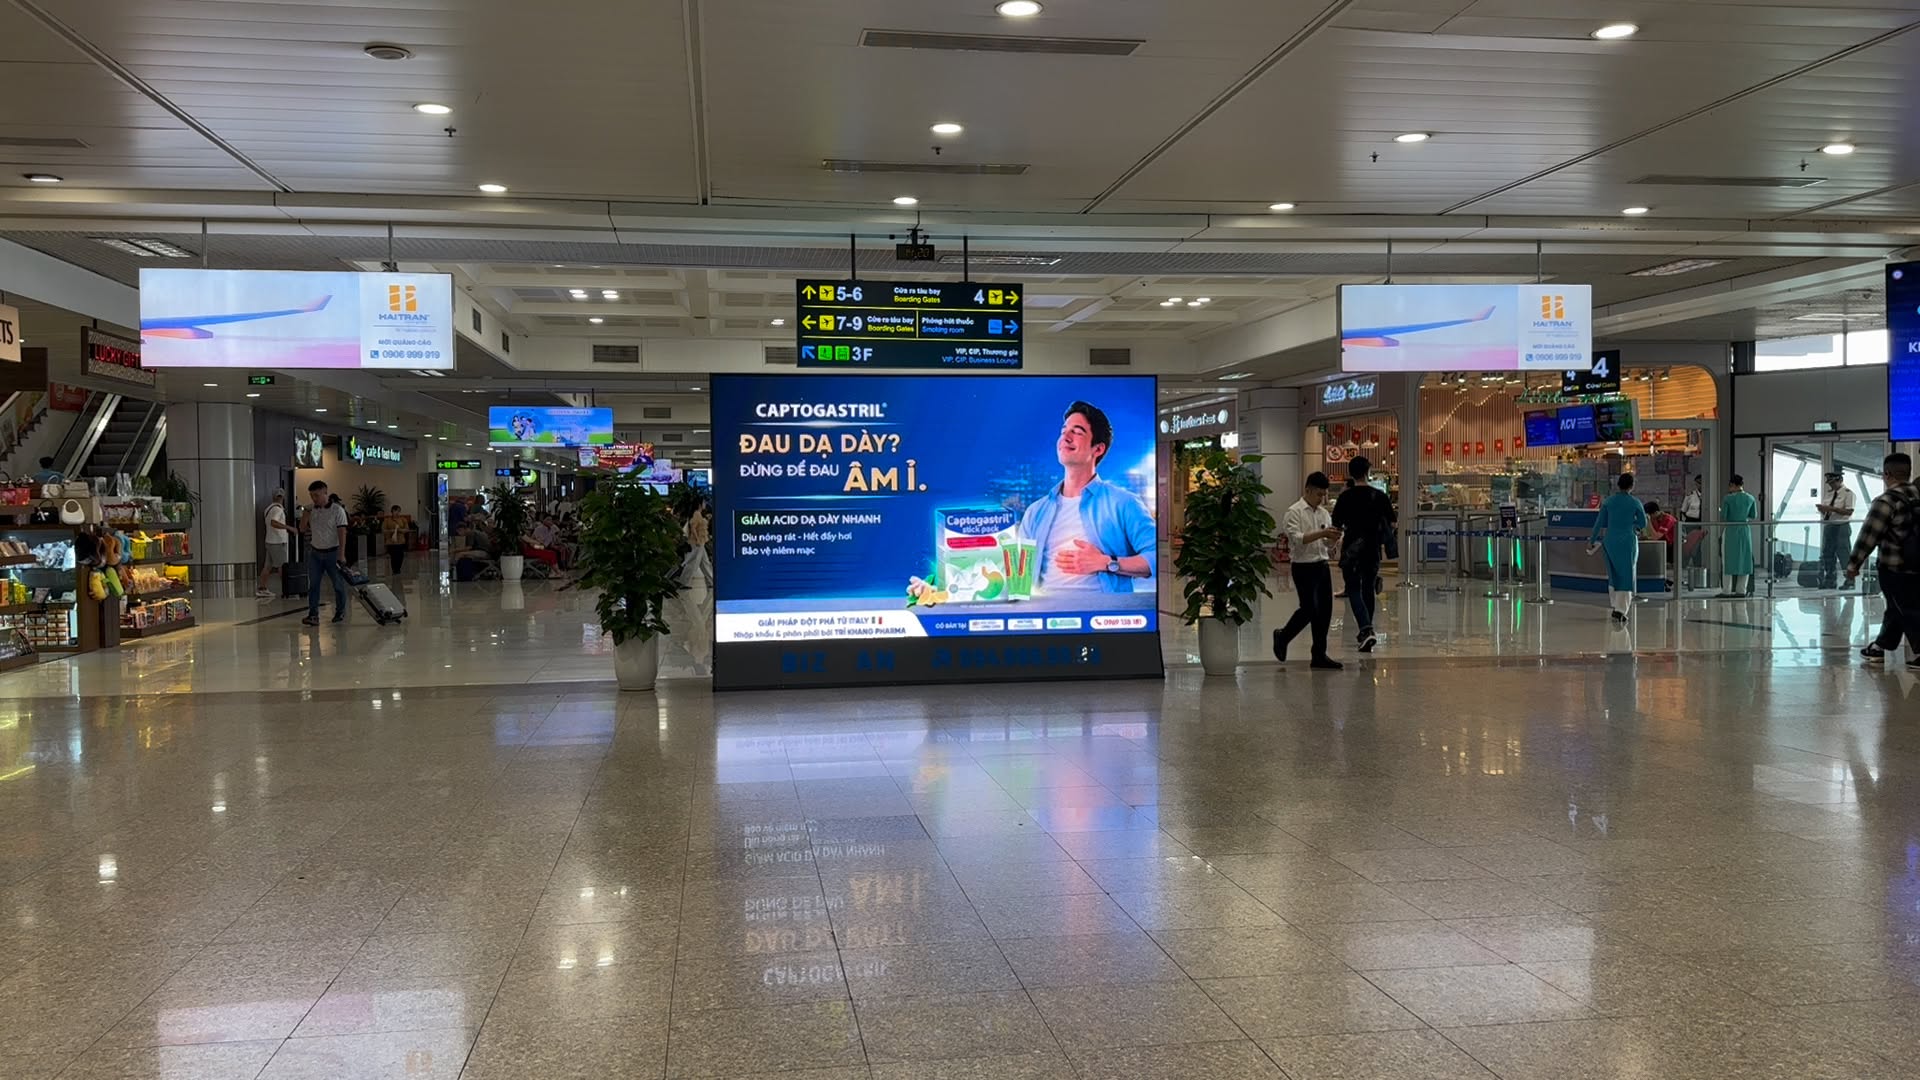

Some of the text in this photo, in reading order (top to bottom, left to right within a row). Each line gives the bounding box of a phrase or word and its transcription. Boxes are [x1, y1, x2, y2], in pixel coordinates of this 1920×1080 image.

[836, 286, 863, 301] 5-6
[928, 288, 941, 296] bay
[973, 289, 985, 304] 4
[893, 296, 921, 304] Boarding
[836, 315, 863, 330] 7-9
[902, 317, 914, 325] bay
[0, 319, 13, 345] TS
[867, 325, 895, 333] Boarding
[921, 326, 948, 334] Smoking
[95, 344, 121, 363] LUCKY
[382, 350, 441, 359] 0906 999 919
[996, 357, 1018, 365] Lounge
[1591, 356, 1609, 378] 4
[1560, 418, 1577, 430] ACV
[739, 428, 901, 459] ĐAU DẠ DÀY?
[740, 460, 783, 477] ĐỪNG
[787, 459, 806, 477] ĐỂ
[810, 464, 840, 477] ĐAU
[741, 512, 881, 527] GIẢM ACID DẠ DÀY NHANH
[946, 513, 1011, 528] Captogastril
[981, 525, 999, 534] pack
[741, 532, 757, 544] Dịu
[759, 531, 782, 544] nóng
[784, 531, 796, 541] rát
[803, 531, 819, 542] Hết
[741, 546, 815, 557] Bảo vệ niêm mạc
[777, 617, 798, 626] PHÁP
[849, 616, 869, 624] ITALY
[847, 627, 873, 635] KHANG
[874, 627, 906, 635] PHARMA
